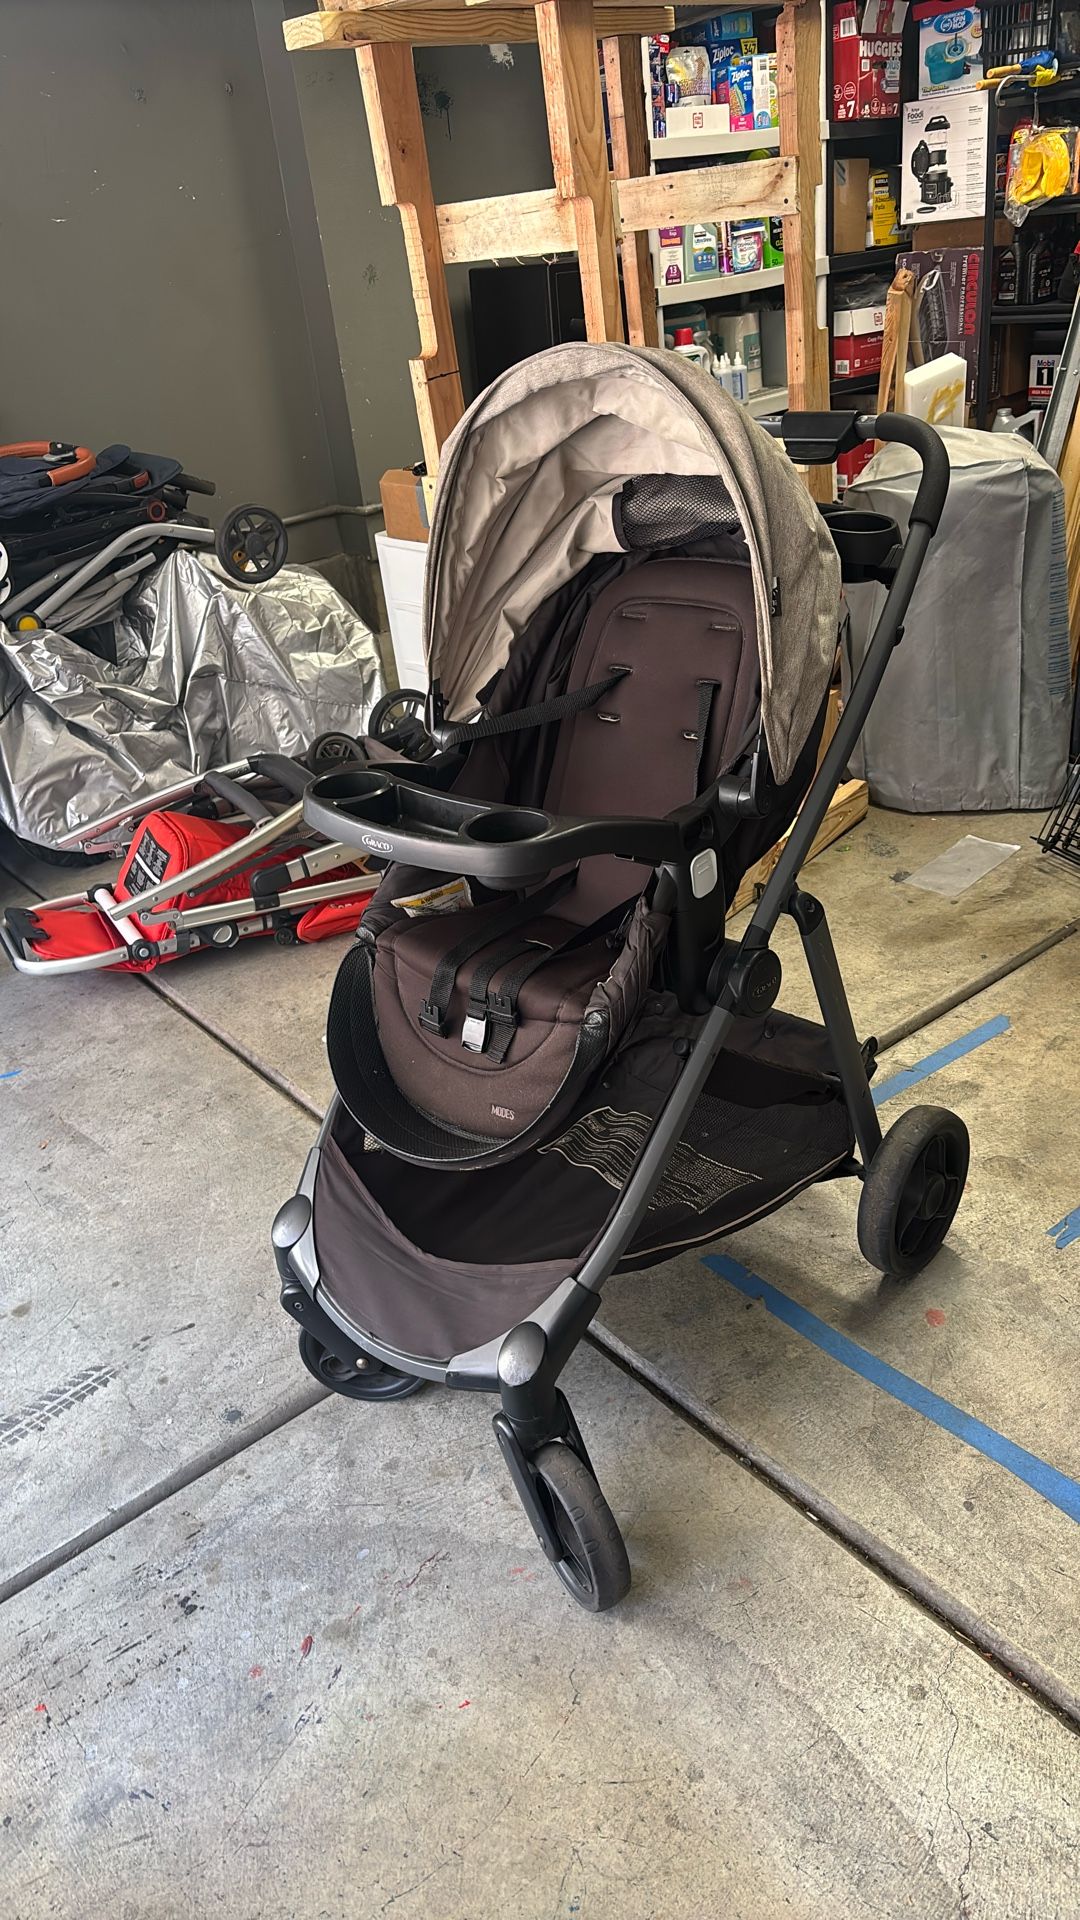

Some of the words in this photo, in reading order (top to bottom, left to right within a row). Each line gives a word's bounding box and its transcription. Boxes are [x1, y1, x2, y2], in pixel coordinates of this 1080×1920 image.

[712, 46, 734, 63] Ziploc
[743, 43, 757, 55] 347
[859, 40, 903, 58] HUGGIES
[731, 69, 750, 83] Ziploc
[846, 100, 855, 118] 7
[670, 265, 678, 274] 13
[960, 255, 968, 282] Premier
[963, 253, 980, 336] CIRCULON
[1037, 360, 1055, 368] Mobil
[1041, 368, 1048, 385] 1
[366, 837, 390, 851] GRACO
[491, 1104, 515, 1121] MODES
